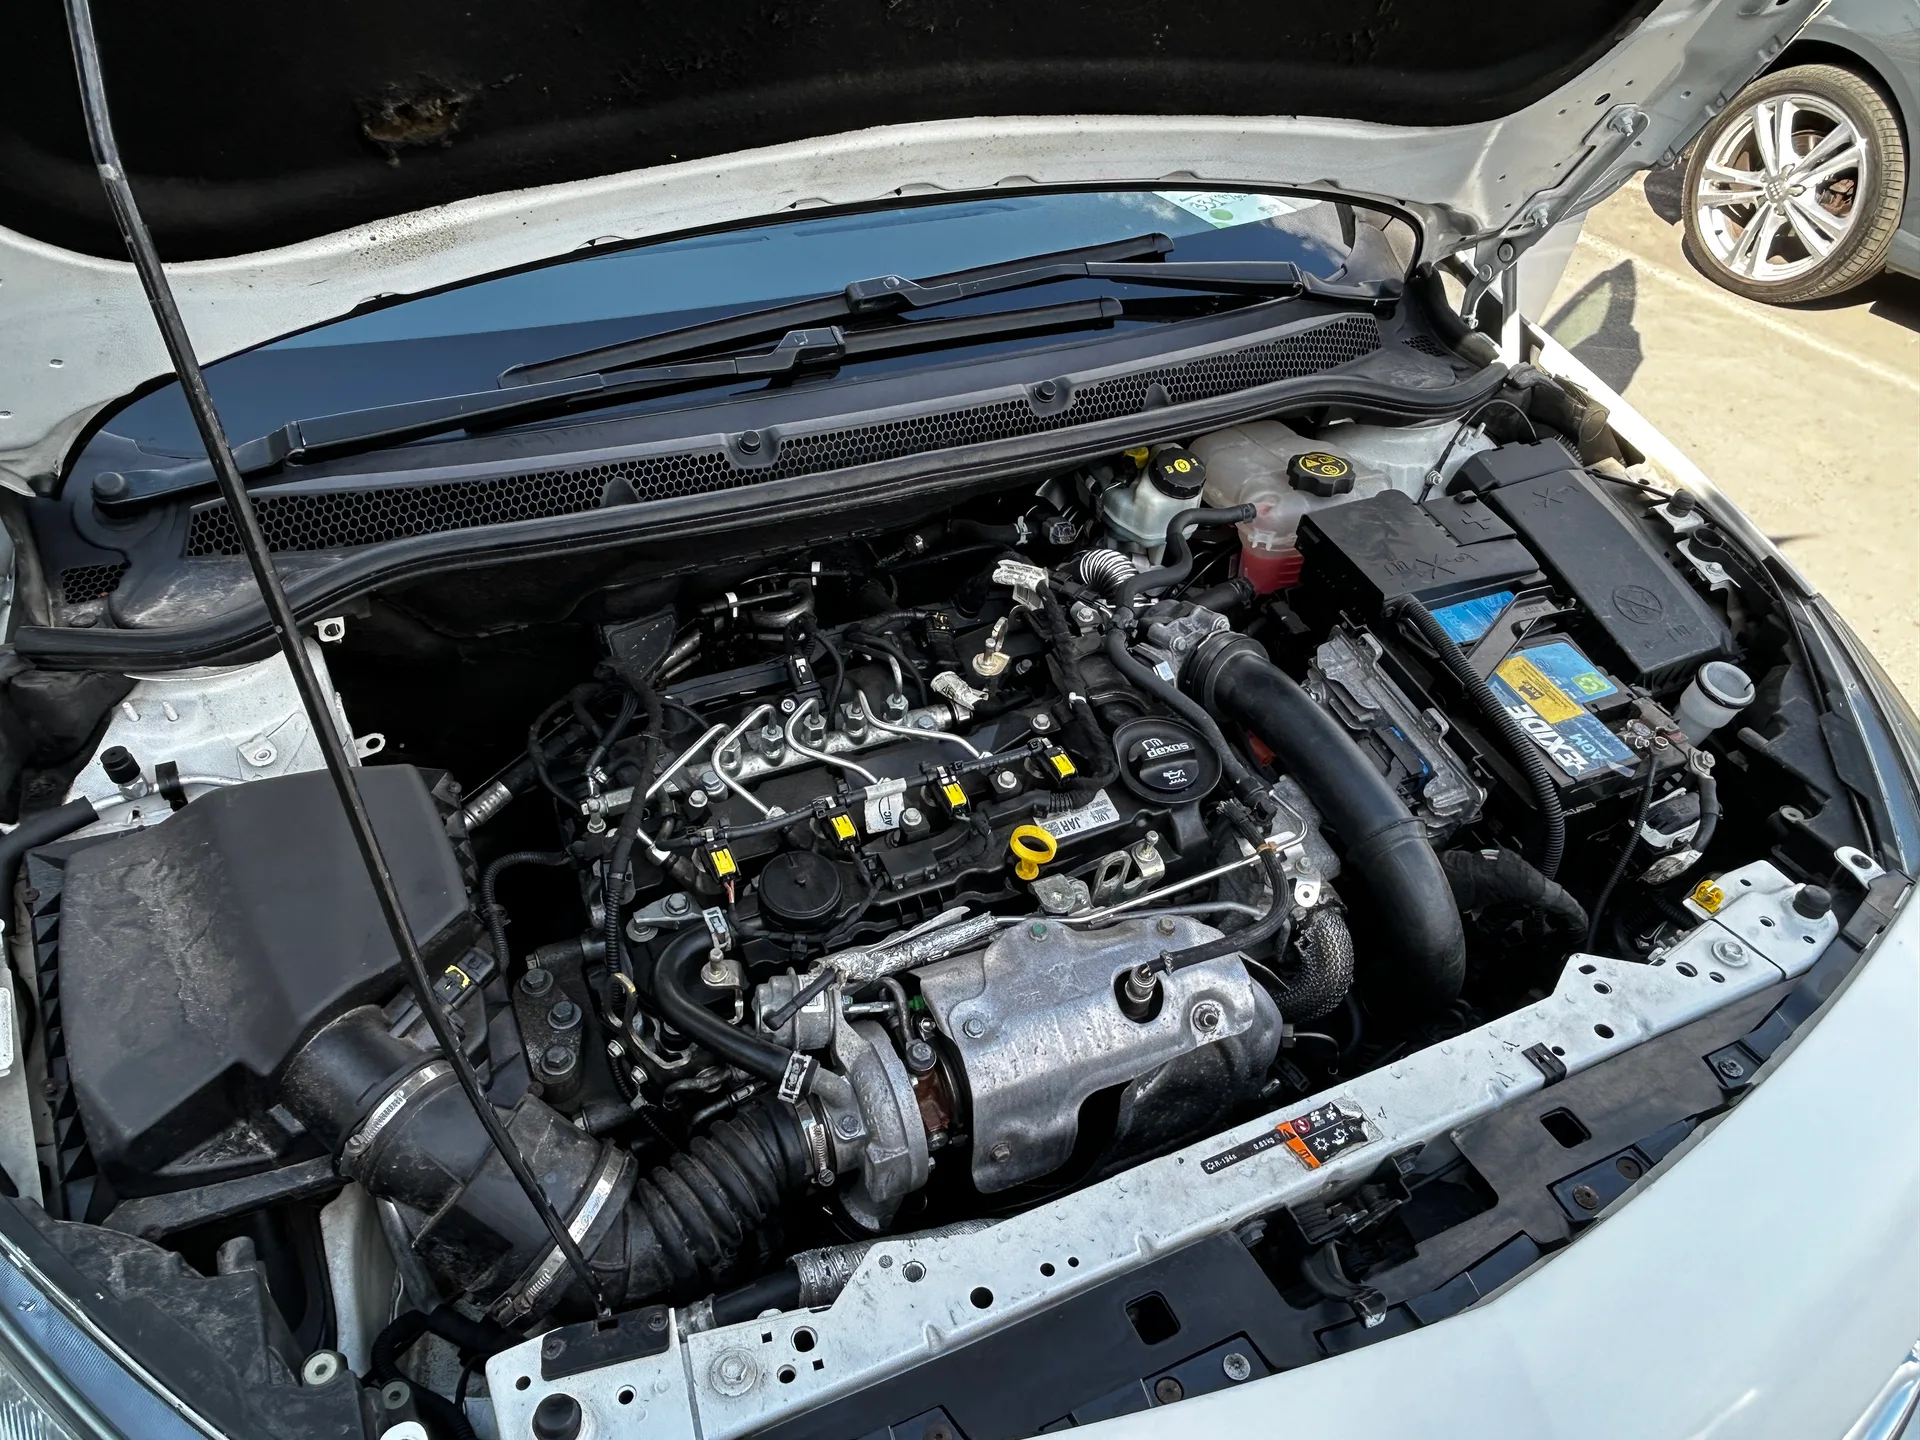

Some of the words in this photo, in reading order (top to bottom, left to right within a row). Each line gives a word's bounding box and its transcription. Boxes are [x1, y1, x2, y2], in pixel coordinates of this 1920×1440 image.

[1504, 704, 1589, 770] EXIDE
[1569, 733, 1607, 759] AGM
[1147, 742, 1189, 758] dexos
[1060, 816, 1082, 832] JAR
